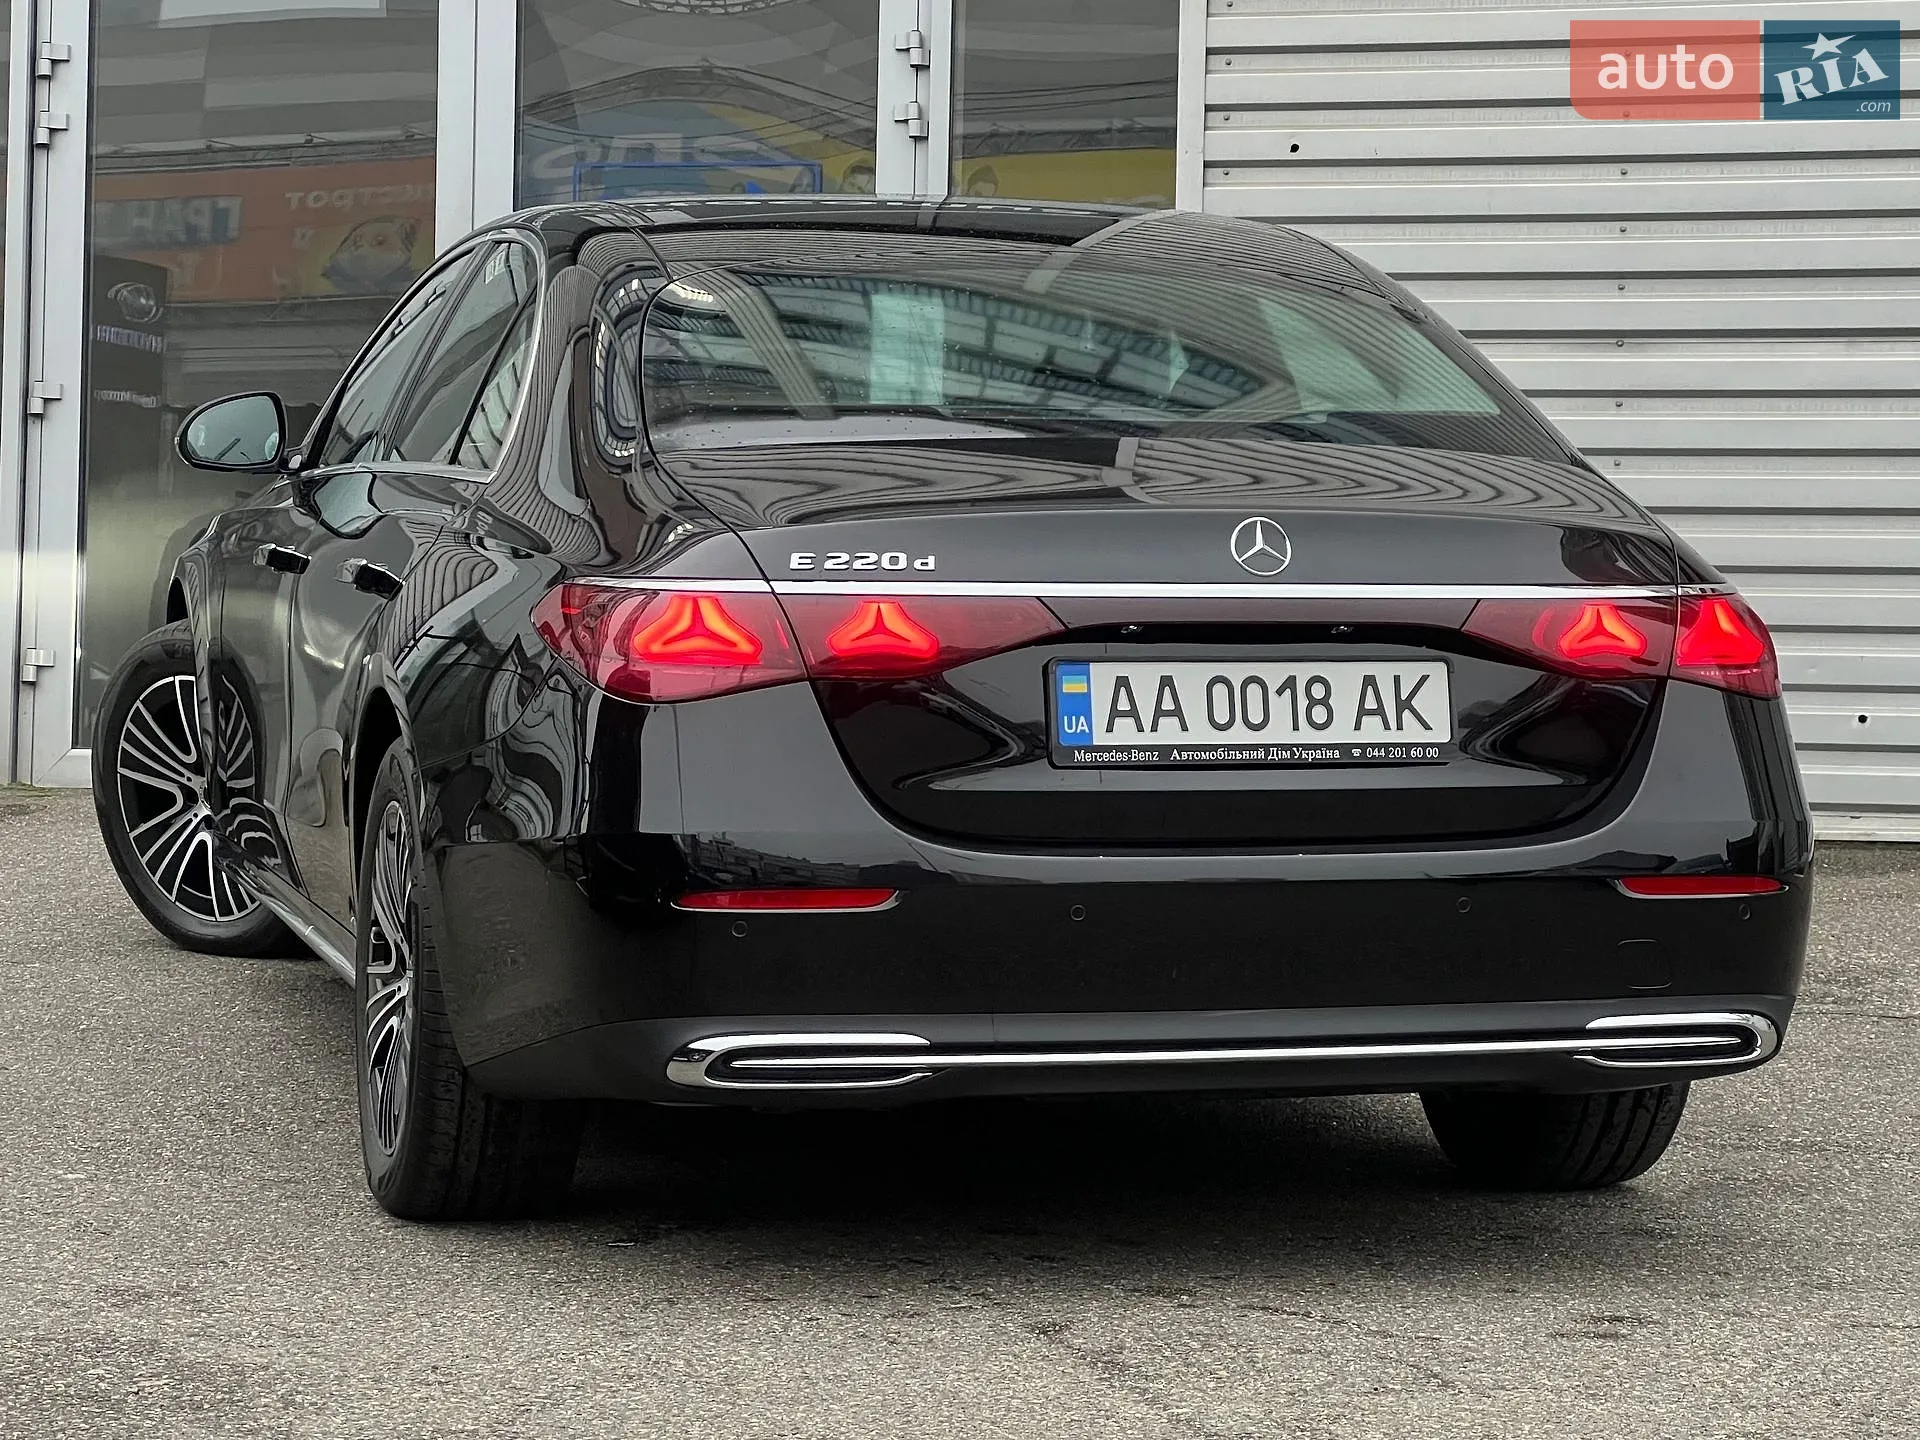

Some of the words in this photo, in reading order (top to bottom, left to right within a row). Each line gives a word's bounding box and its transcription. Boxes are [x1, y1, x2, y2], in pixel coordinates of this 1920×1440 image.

[789, 552, 817, 571] E
[823, 552, 908, 571] 220
[913, 555, 936, 571] d
[1105, 675, 1189, 732] AA
[1206, 674, 1334, 731] 0018
[1353, 674, 1433, 731] AK
[1063, 716, 1090, 733] UA
[1074, 750, 1159, 762] Mercedes-Benz
[1170, 748, 1265, 760] Автомобільний
[1268, 747, 1290, 761] Дім
[1293, 747, 1341, 762] Україна
[1366, 747, 1386, 759] 044
[1388, 747, 1407, 759] 201
[1410, 747, 1424, 758] 60
[1426, 747, 1440, 758] 00
